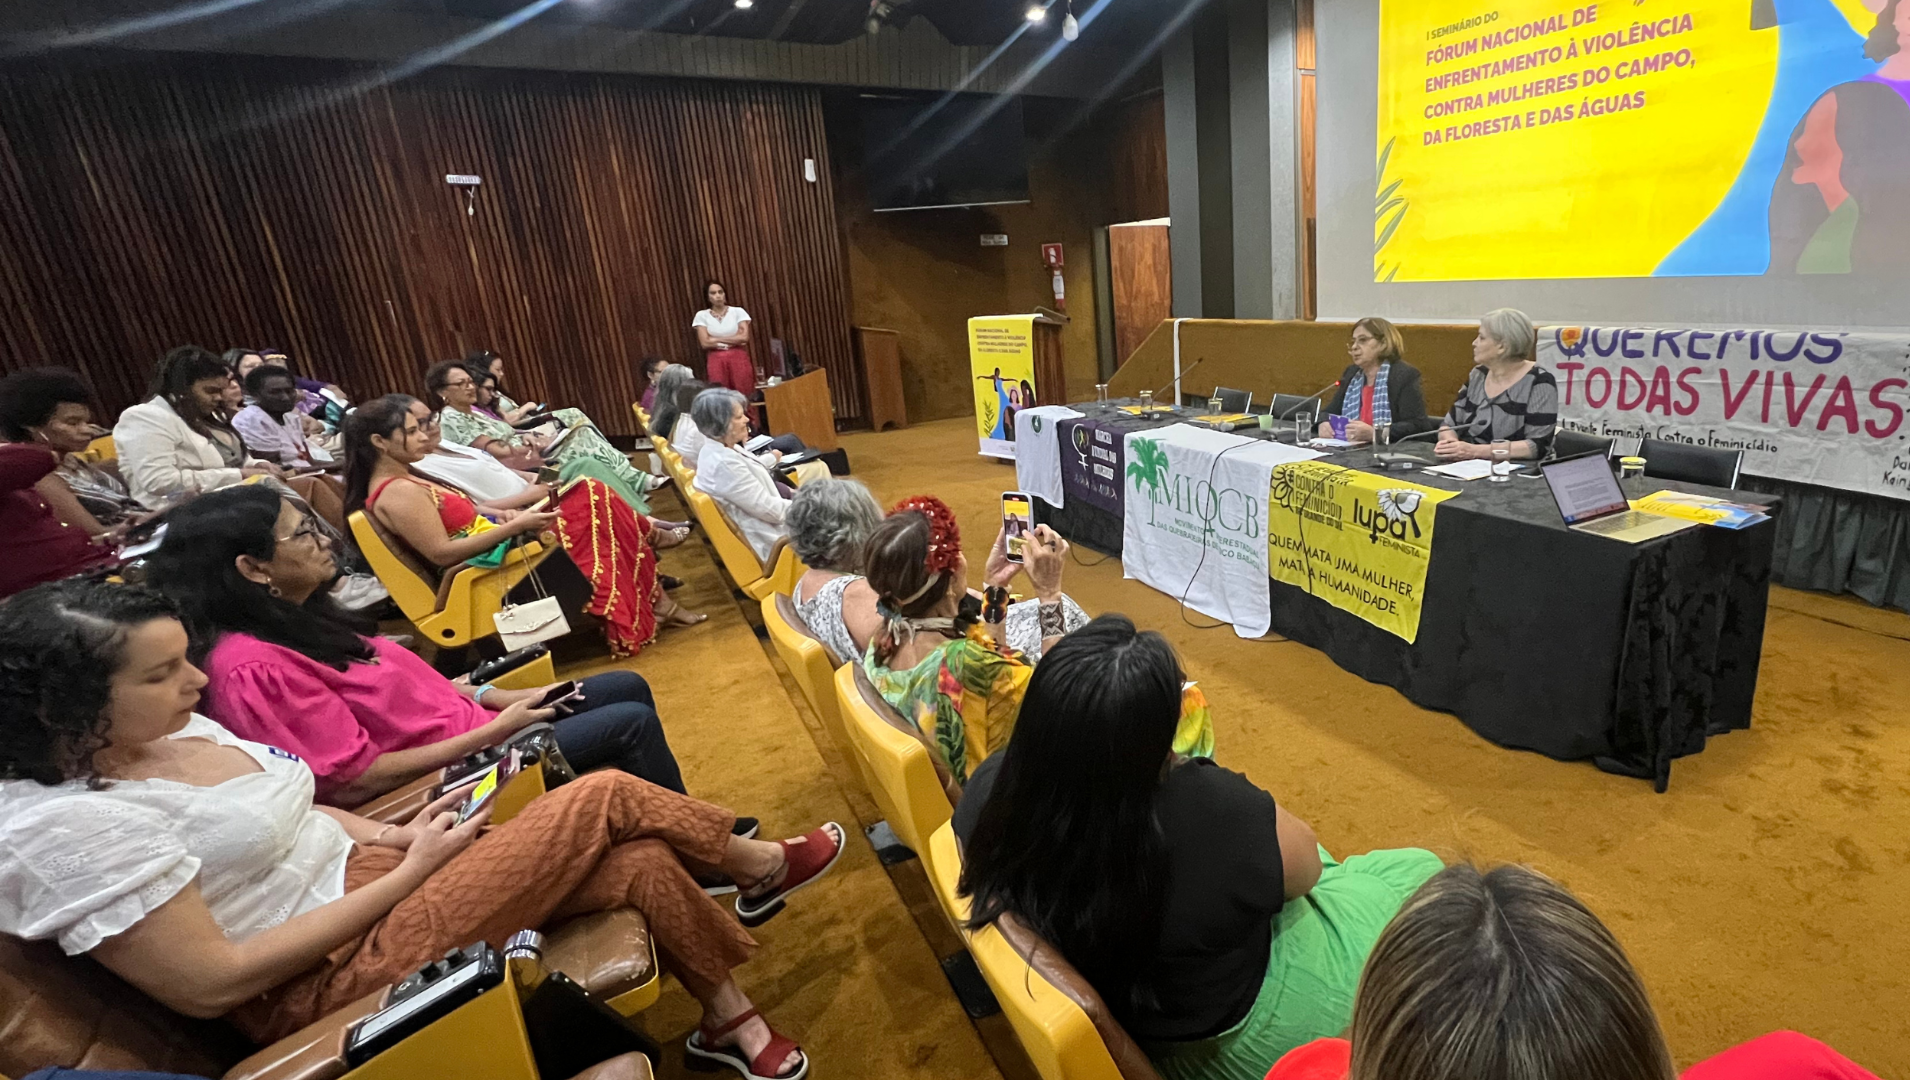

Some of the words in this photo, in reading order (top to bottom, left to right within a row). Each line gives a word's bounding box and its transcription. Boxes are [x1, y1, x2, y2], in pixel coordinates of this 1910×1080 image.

[1425, 46, 1563, 93] ENFRENTAMENTO
[1566, 38, 1578, 60] À
[1582, 13, 1693, 55] VIOLÊNCIA
[1426, 38, 1478, 66] FÓRUM
[1481, 14, 1568, 52] NACIONAL
[1572, 4, 1598, 27] DE
[1431, 16, 1482, 40] SEMINÁRIO
[1483, 10, 1499, 25] DO
[1424, 93, 1484, 119] CONTRA
[1487, 73, 1578, 107] MULHERES
[1582, 66, 1610, 87] DO
[1614, 48, 1696, 80] CAMPO,
[1423, 130, 1442, 146] DA
[1445, 114, 1521, 142] FLORESTA
[1525, 111, 1535, 128] E
[1539, 104, 1574, 125] DAS
[1577, 90, 1646, 119] ÁGUAS
[1556, 327, 1849, 364] QUEREMOS
[1556, 361, 1702, 416] TODAS
[1719, 368, 1909, 439] VIVAS
[1562, 418, 1598, 435] Levante
[1601, 420, 1652, 439] Feminista
[1656, 425, 1694, 445] Contra
[1708, 429, 1778, 453] Feminicídio
[1155, 467, 1259, 539] MIQCB
[1296, 474, 1326, 498] CONTRA
[1157, 520, 1168, 532] DAS
[1354, 498, 1407, 541] lupa
[1378, 536, 1421, 558] FEMINISTA
[1268, 533, 1302, 552] QUEM
[1305, 545, 1332, 565] MATA
[1362, 567, 1415, 602] MULHER,
[1279, 556, 1306, 576] MATA
[1319, 571, 1400, 617] HUMANIDADE.
